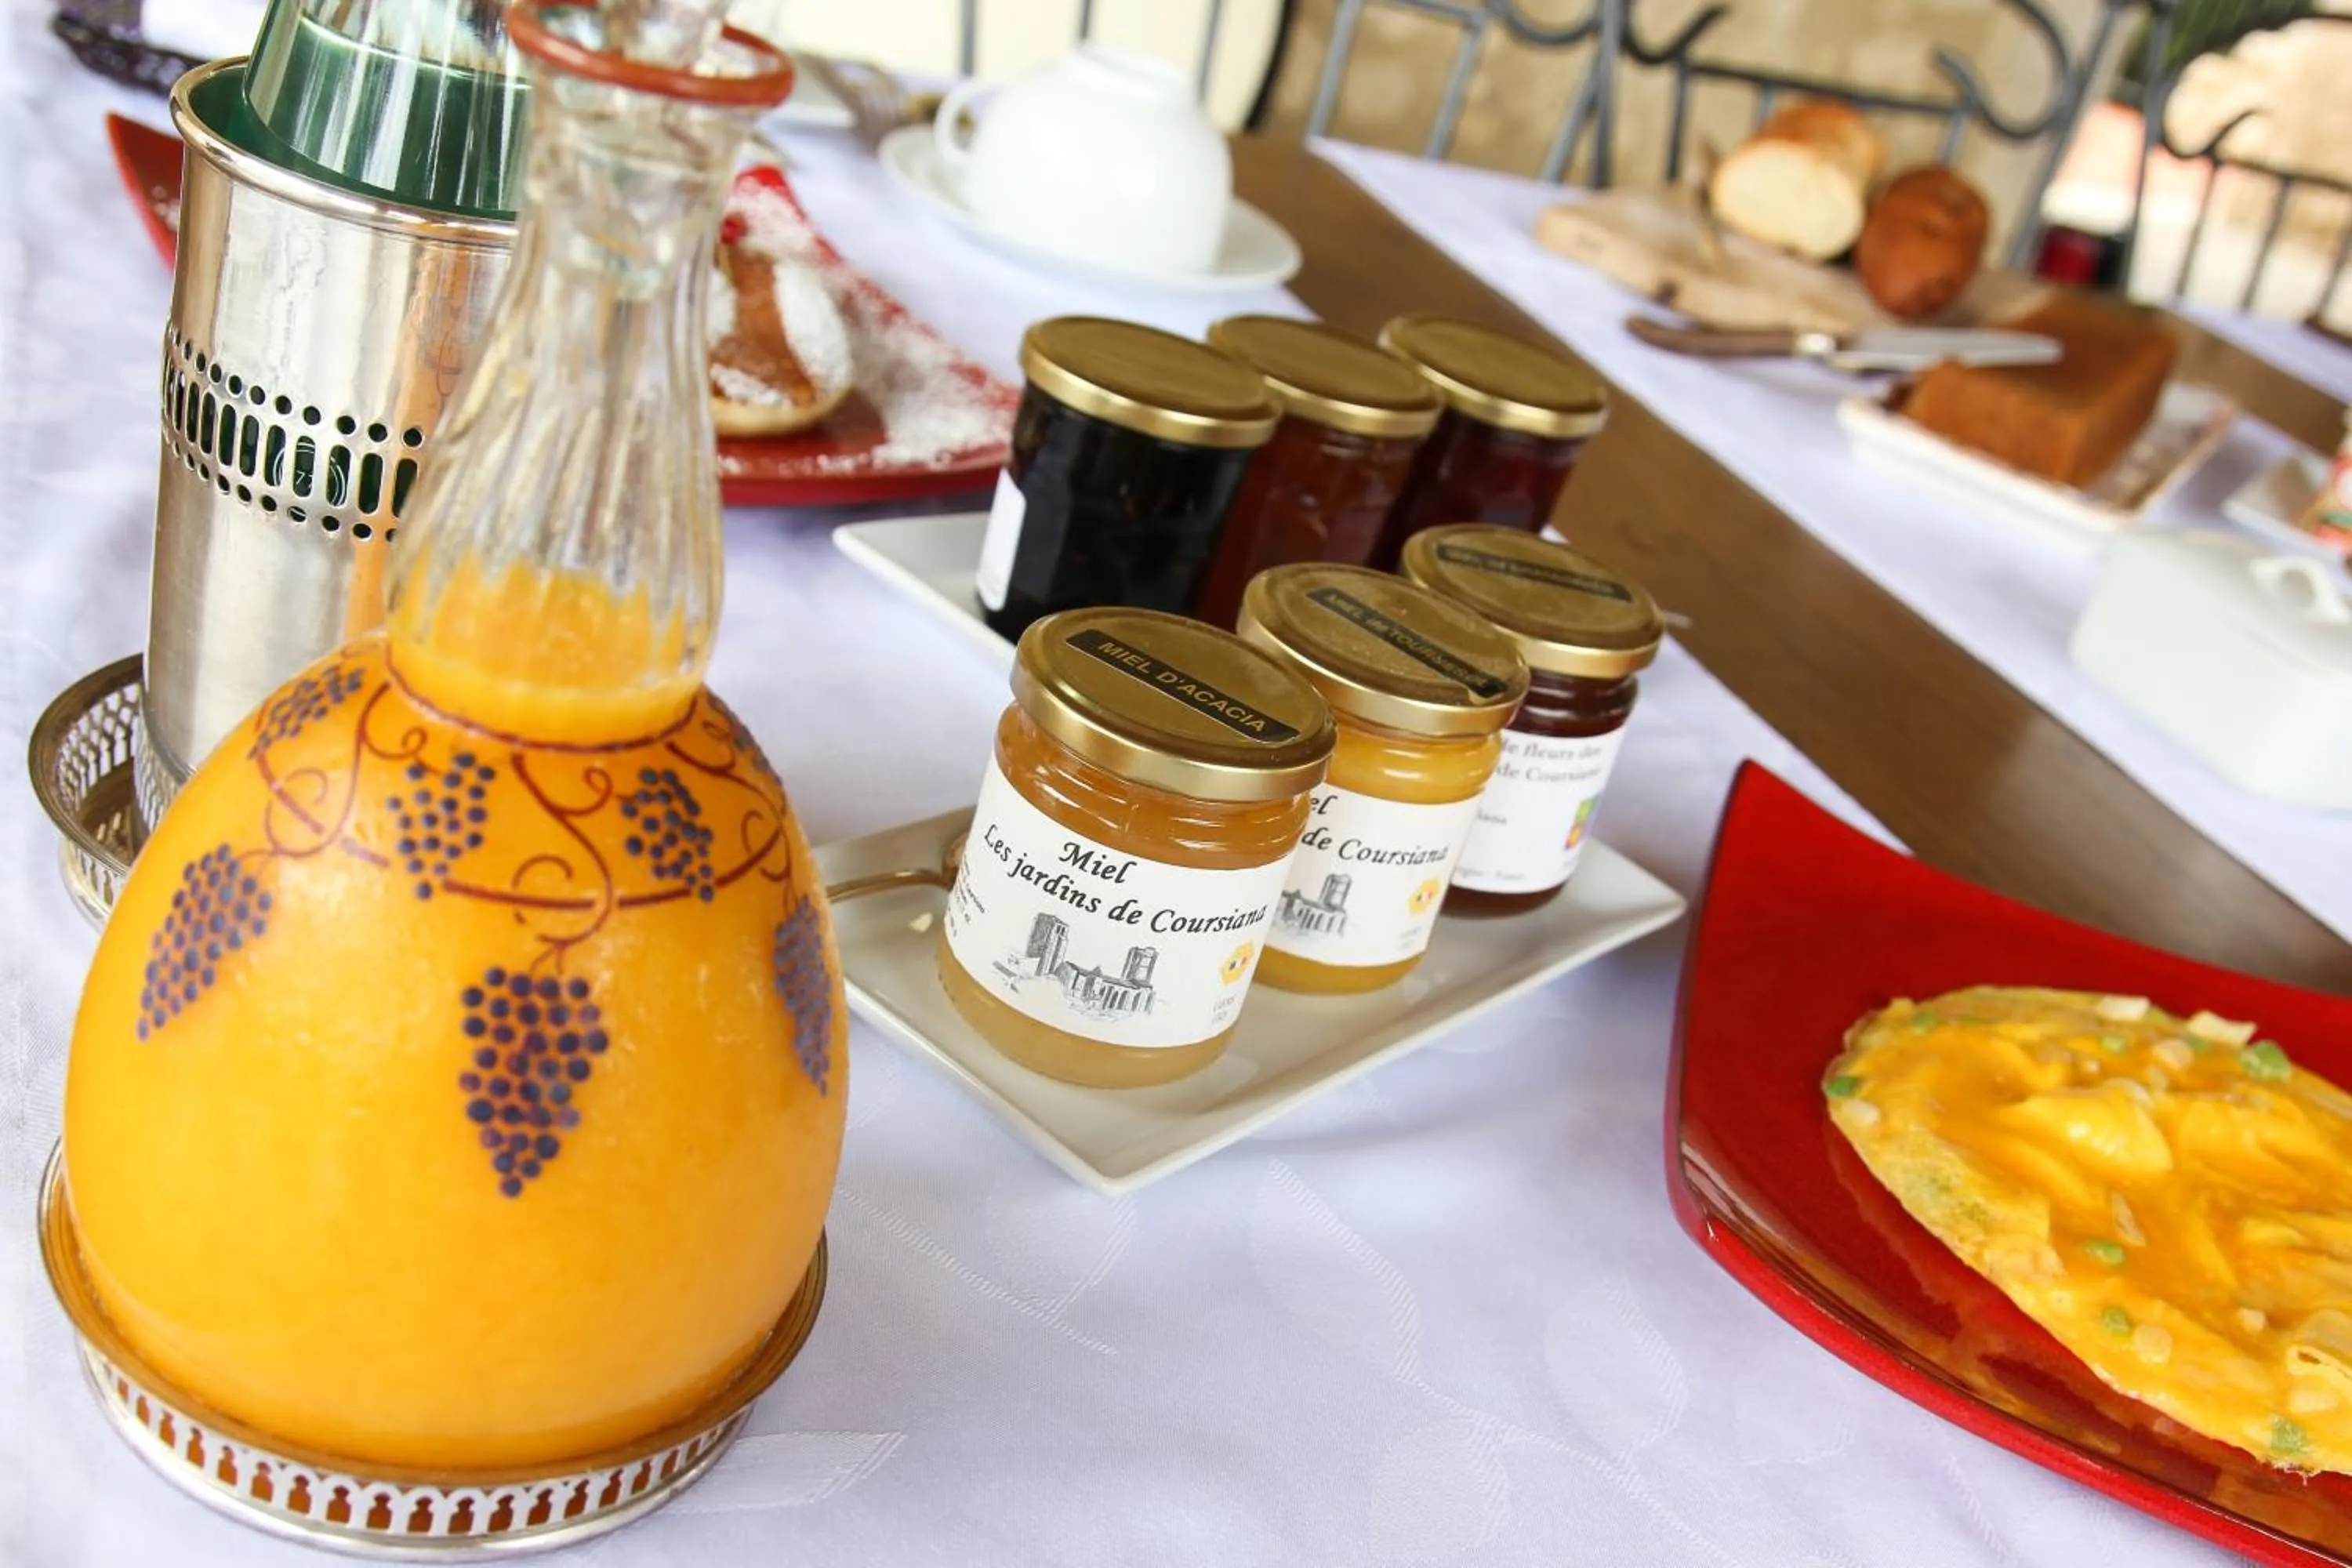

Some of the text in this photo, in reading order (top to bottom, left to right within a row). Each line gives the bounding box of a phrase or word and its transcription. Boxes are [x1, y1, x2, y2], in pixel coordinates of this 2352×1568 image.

[1098, 641, 1267, 732] MIEL D'ACACIA
[1310, 794, 1338, 815] el
[1058, 841, 1138, 884] Miel
[1301, 826, 1449, 866] de Coursiana
[984, 823, 1012, 862] Les
[1007, 852, 1102, 914] jardins
[1108, 898, 1143, 925] de
[1149, 904, 1269, 934] Coursiana
